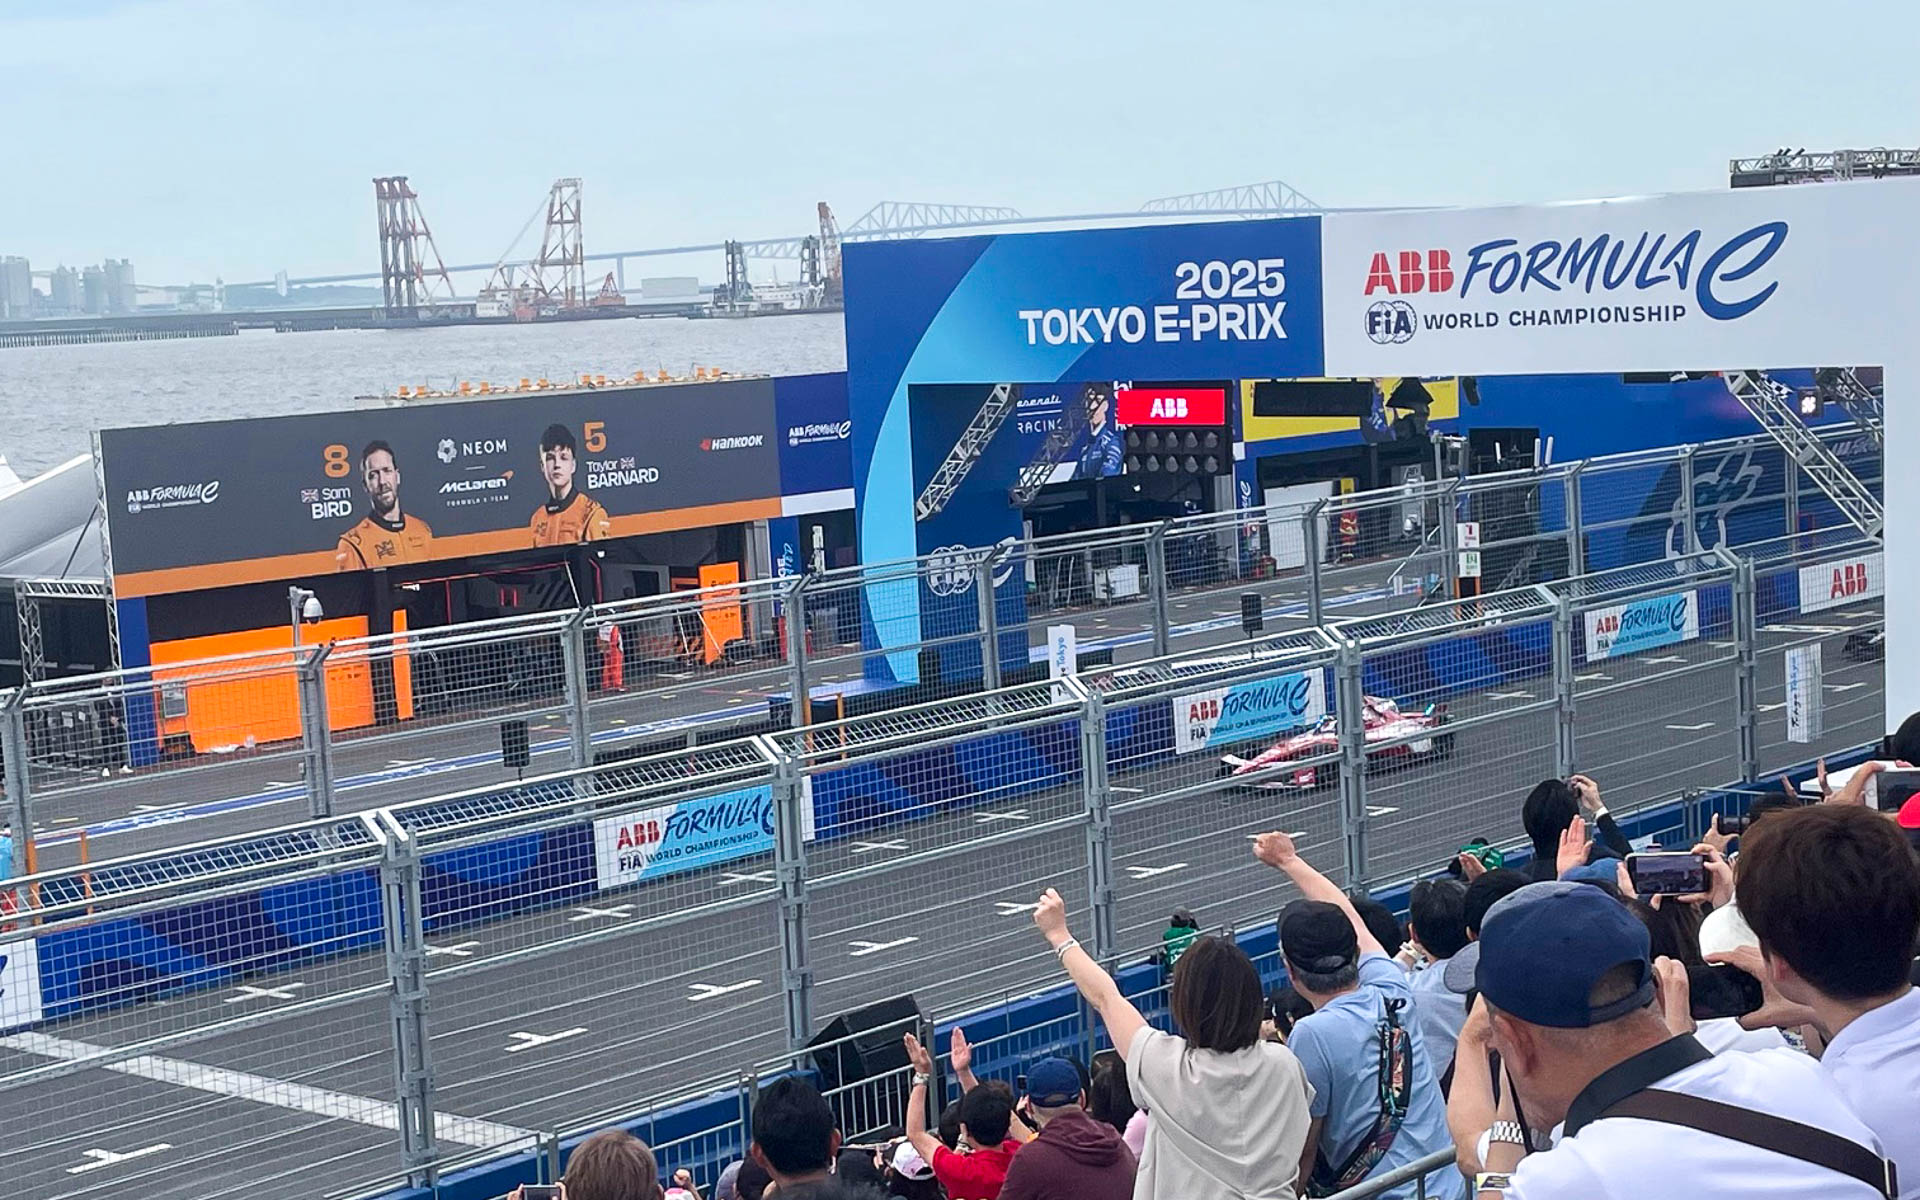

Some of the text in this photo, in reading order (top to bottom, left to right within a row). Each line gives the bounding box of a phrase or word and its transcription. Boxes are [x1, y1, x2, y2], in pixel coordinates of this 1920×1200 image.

[1175, 258, 1286, 300] 2025
[1364, 249, 1454, 295] ABB
[1460, 229, 1700, 299] FORMULA
[1018, 302, 1288, 345] TOKYO E-PRIX
[1424, 312, 1499, 329] WORLD
[1509, 305, 1686, 326] CHAMPIONSHIP
[1016, 395, 1062, 408] aserati
[1150, 398, 1189, 419] ABB
[463, 439, 508, 456] NEOM
[583, 422, 606, 453] 5
[324, 444, 351, 478] 8
[586, 459, 618, 473] Taylor
[127, 490, 149, 503] ABB
[150, 484, 202, 501] FORMULA
[322, 487, 351, 500] Sam
[439, 478, 507, 493] McLaren
[587, 468, 659, 489] BARNARD
[311, 500, 353, 519] BIRD
[1830, 563, 1868, 600] ABB
[1596, 615, 1619, 635] ABB
[1620, 603, 1671, 632] FORMULA
[1057, 637, 1068, 668] Tokyo
[1189, 700, 1219, 724] ABB
[1220, 681, 1290, 720] FORMULA
[617, 819, 660, 851] ABB
[663, 794, 763, 843] FORMULA
[645, 847, 682, 863] WORLD
[685, 831, 759, 855] CHAMPIONSHIP
